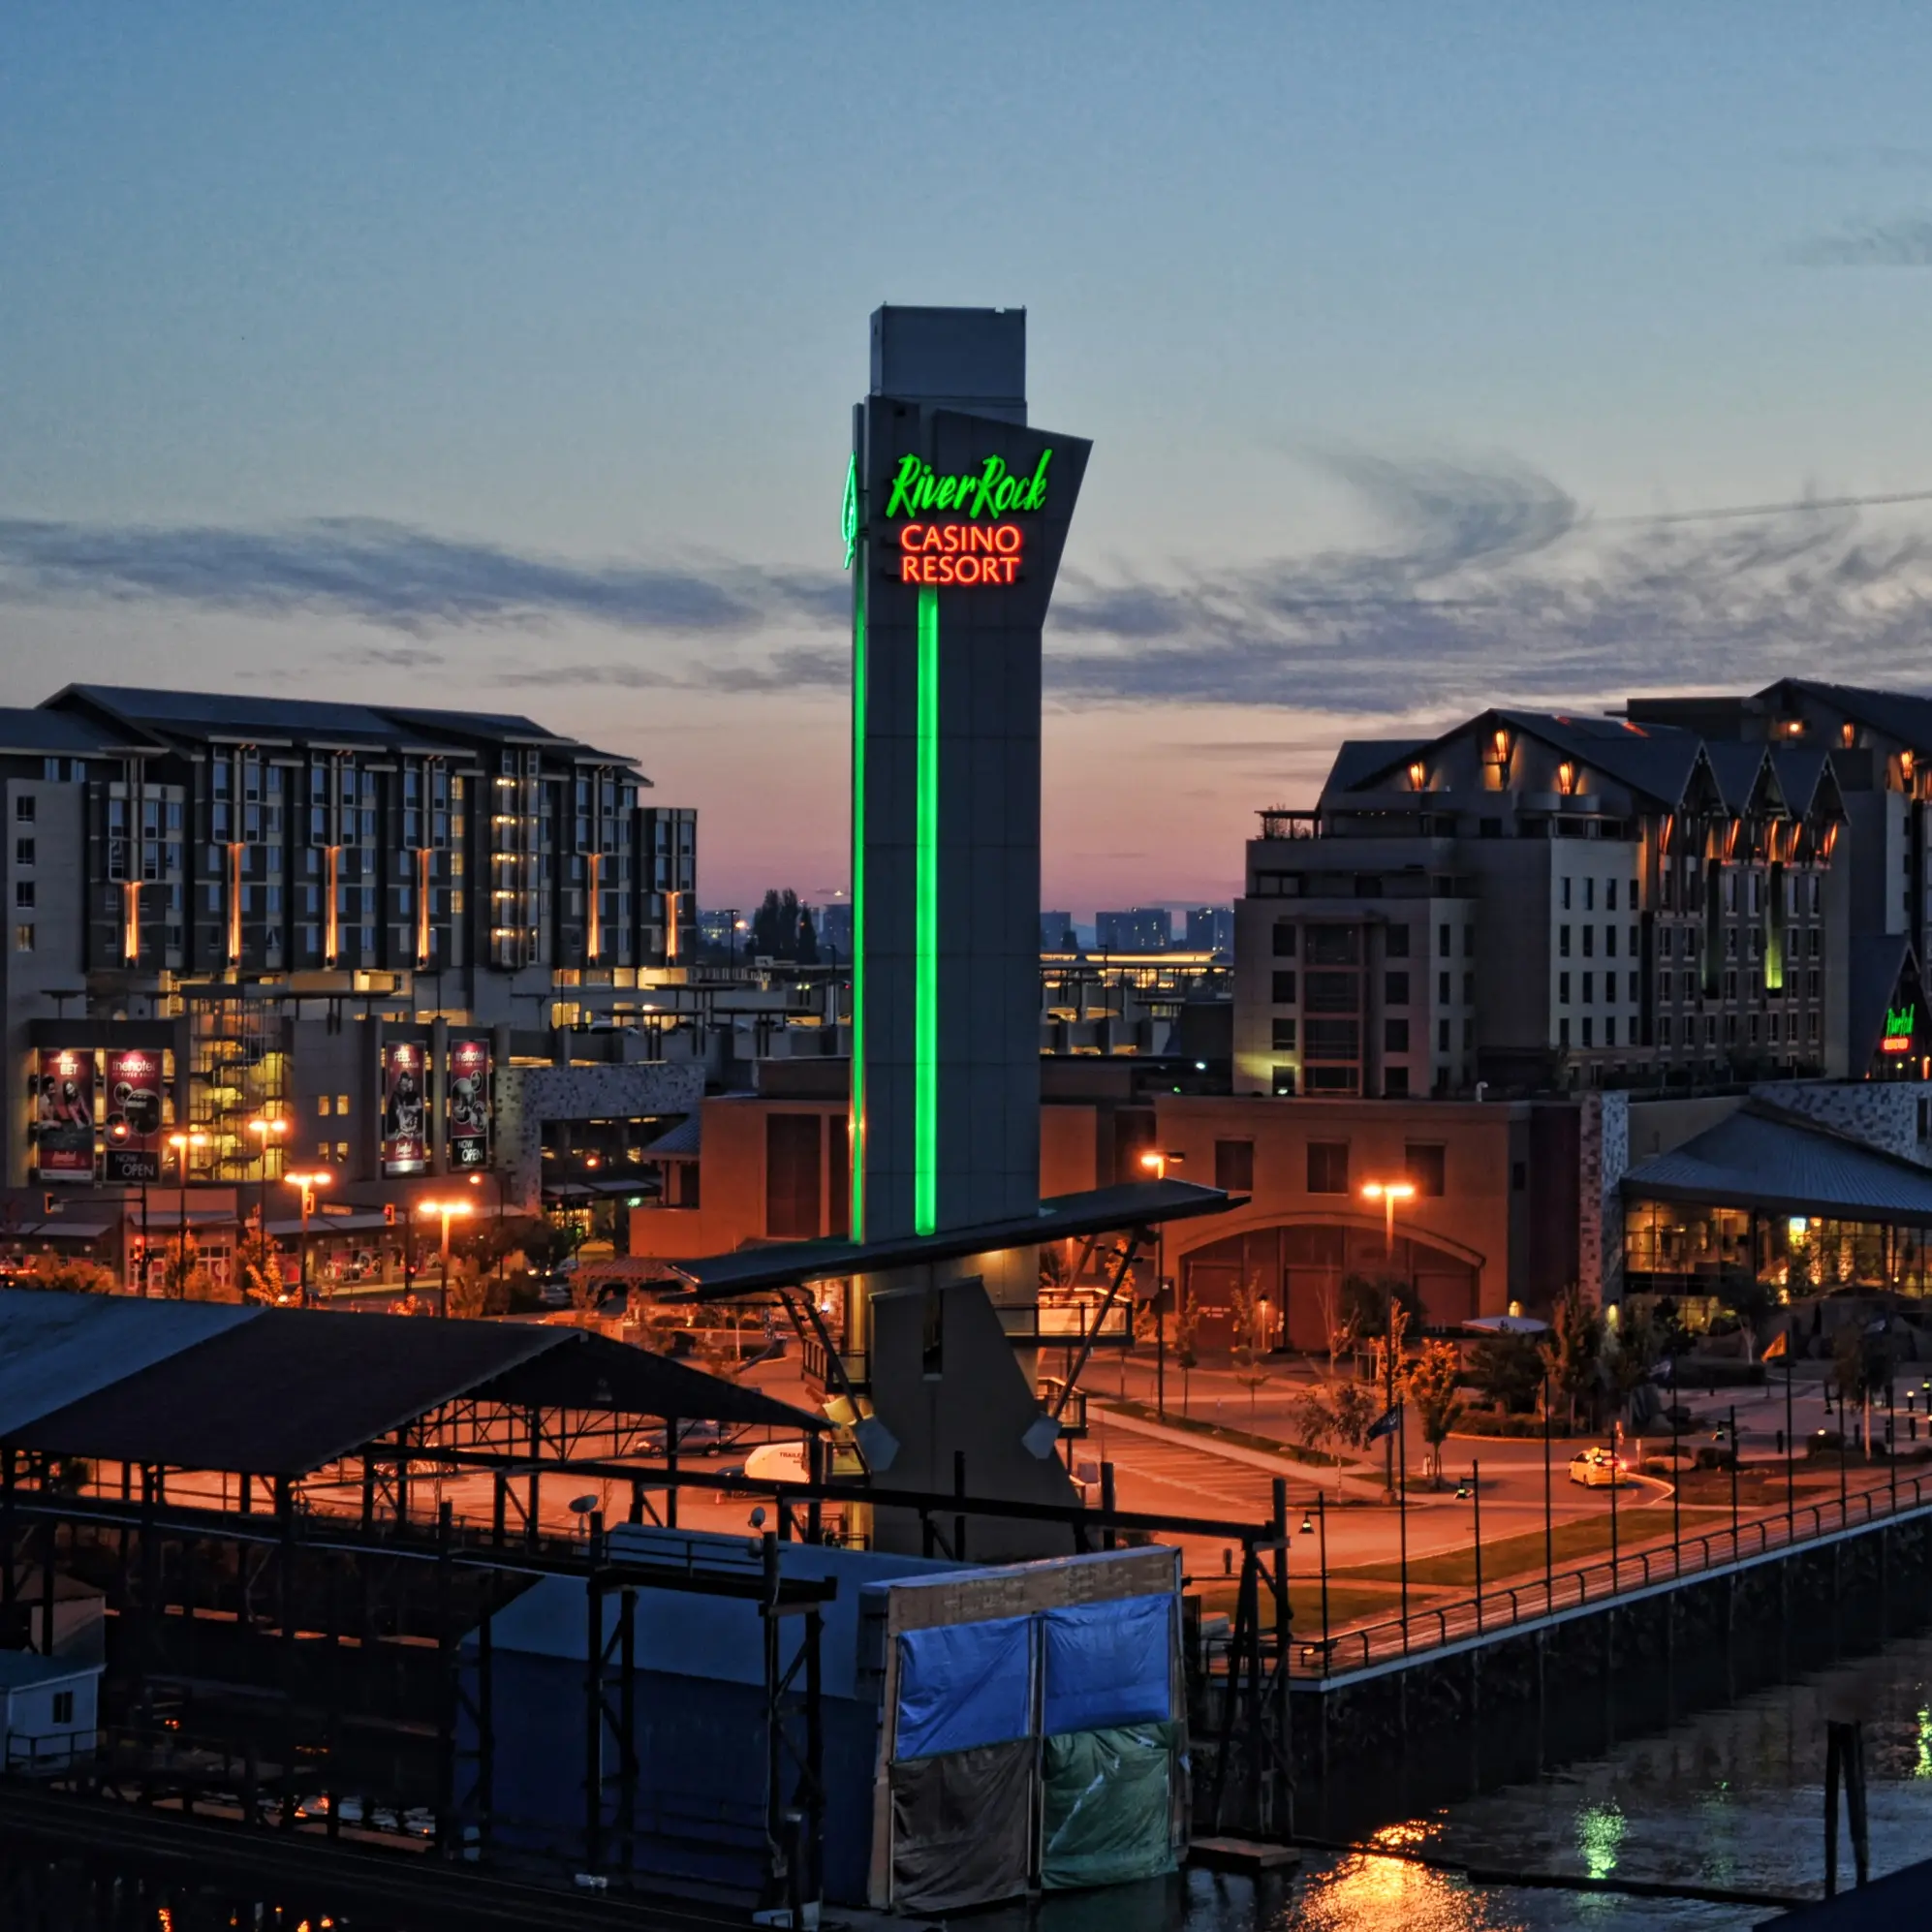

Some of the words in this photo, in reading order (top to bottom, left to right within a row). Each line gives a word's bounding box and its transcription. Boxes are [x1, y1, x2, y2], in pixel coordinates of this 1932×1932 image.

[901, 524, 1020, 552] CASINO
[902, 555, 1020, 583] RESORT
[457, 1139, 474, 1148] NOW
[115, 1153, 139, 1163] NOW
[461, 1149, 483, 1162] OPEN
[122, 1164, 154, 1177] OPEN
